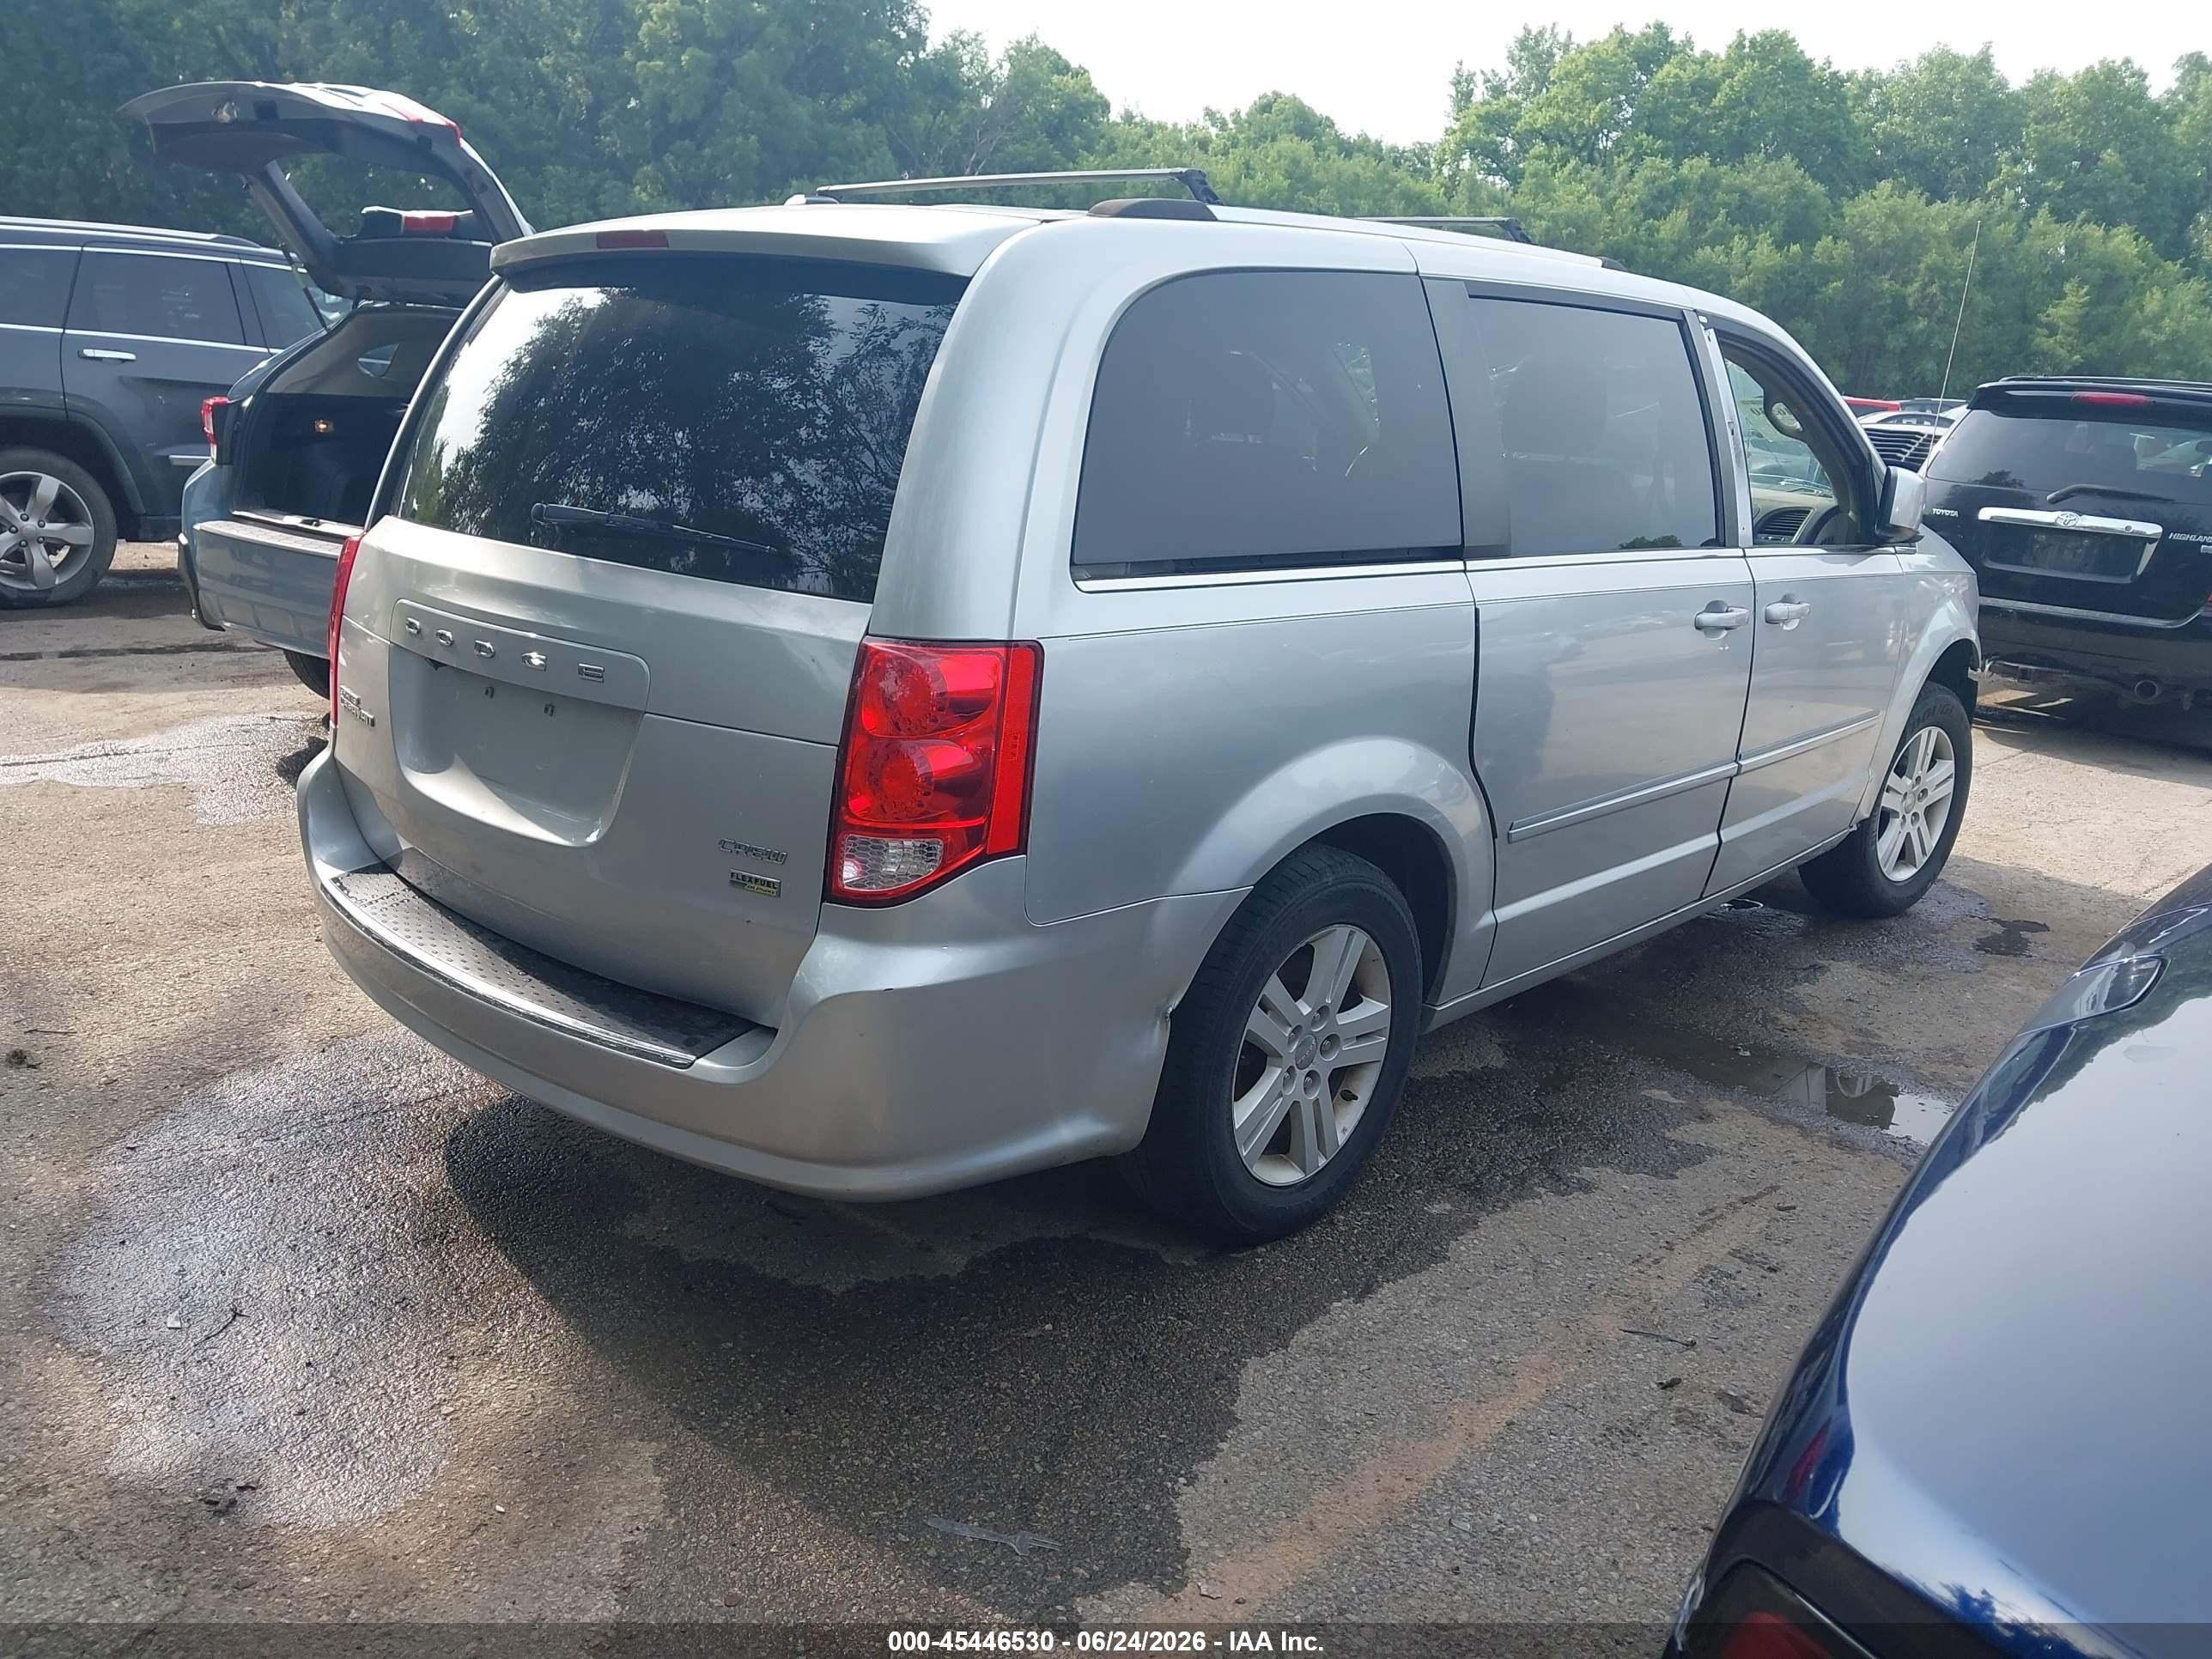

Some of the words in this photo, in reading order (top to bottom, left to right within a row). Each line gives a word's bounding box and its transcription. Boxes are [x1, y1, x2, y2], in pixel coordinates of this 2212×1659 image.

[1932, 507, 1959, 518] TOYOTA
[2168, 532, 2212, 543] HIGHLAN
[405, 617, 605, 684] DODGE
[718, 838, 788, 865] CREW
